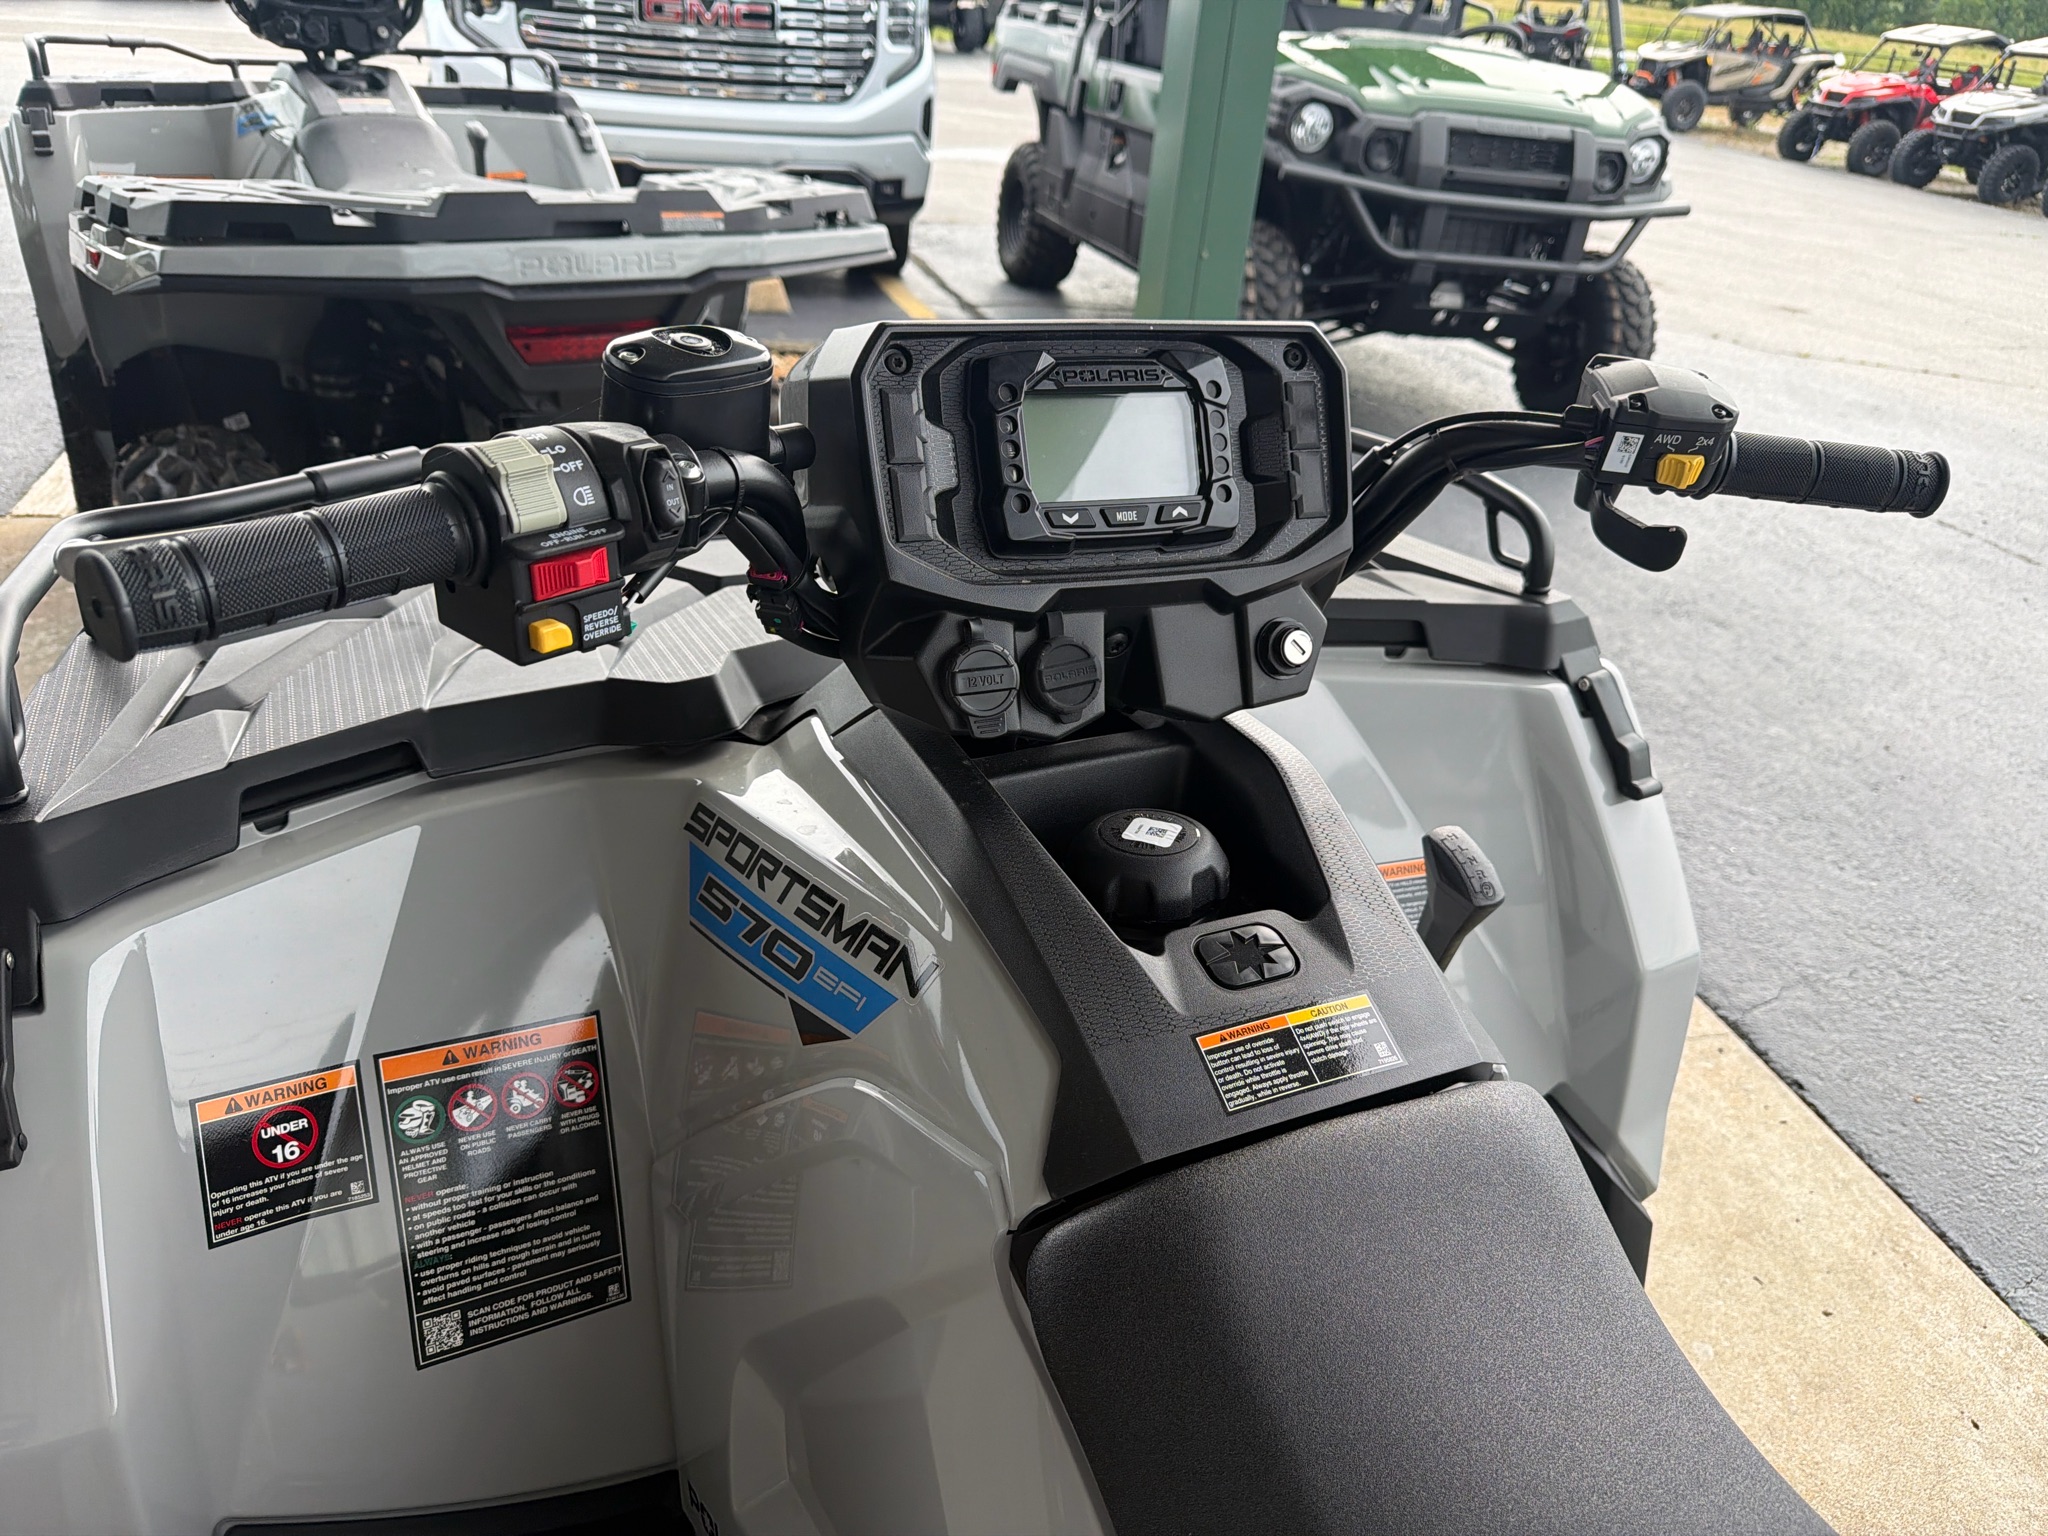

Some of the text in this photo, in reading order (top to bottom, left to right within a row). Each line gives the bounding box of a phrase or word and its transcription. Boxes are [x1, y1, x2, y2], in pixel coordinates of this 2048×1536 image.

[642, 0, 773, 29] GMC
[516, 250, 676, 279] POLARIS
[1062, 370, 1160, 382] POLARIS
[1654, 434, 1714, 447] AWD 2x4
[560, 460, 584, 473] OFF
[666, 498, 680, 506] OUT
[1116, 510, 1138, 522] MODE
[548, 527, 588, 540] ENGINE
[583, 606, 618, 623] SPEEDO/
[584, 616, 619, 632] REVERSE
[583, 624, 622, 642] OVERRIDE
[968, 674, 1004, 688] 12 VOLT
[1045, 664, 1096, 684] POLARIS
[683, 801, 942, 999] SPORTSMAN
[697, 873, 870, 1012] 570 EFI
[1309, 1002, 1348, 1017] CAUTION
[1226, 1021, 1270, 1039] WARNING
[462, 1033, 541, 1058] WARNING
[1206, 1048, 1233, 1060] Improper
[1243, 1042, 1252, 1050] of
[1251, 1037, 1274, 1047] override
[1210, 1058, 1230, 1068] button
[1240, 1050, 1254, 1059] lead
[1272, 1043, 1281, 1051] of
[1214, 1064, 1235, 1074] control
[1234, 1058, 1260, 1069] resulting
[1265, 1052, 1284, 1060] severe
[1283, 1047, 1300, 1055] injury
[386, 1082, 422, 1094] Improper
[424, 1078, 440, 1086] ATV
[471, 1066, 492, 1076] result
[501, 1057, 533, 1070] SEVERE
[534, 1052, 562, 1062] INJURY
[571, 1044, 596, 1054] DEATH
[1224, 1071, 1243, 1081] death.
[1263, 1059, 1285, 1070] activate
[1221, 1079, 1245, 1090] override
[1244, 1075, 1260, 1083] while
[1260, 1069, 1281, 1079] throttle
[1224, 1070, 1308, 1098] engaged. Always apply throttle
[244, 1077, 327, 1107] WARNING
[1228, 1094, 1257, 1107] gradually,
[1256, 1089, 1272, 1097] while
[1278, 1081, 1301, 1091] reverse.
[559, 1111, 600, 1126] WITH DRUGS
[561, 1105, 596, 1119] NEVER USE
[260, 1118, 308, 1138] UNDER
[505, 1116, 551, 1132] NEVER CARRY
[507, 1123, 552, 1138] PASSENGERS
[571, 1119, 601, 1131] ALCOHOL
[458, 1129, 496, 1143] NEVER USE
[471, 1137, 496, 1147] PUBLIC
[272, 1140, 300, 1163] 16
[400, 1141, 445, 1156] ALWAYS USE
[410, 1148, 448, 1162] APPROVED
[467, 1146, 491, 1156] ROADS
[401, 1156, 446, 1171] HELMET AND
[403, 1164, 447, 1179] PROTECTIVE
[210, 1184, 247, 1199] Operating
[248, 1180, 263, 1188] this
[264, 1174, 278, 1183] ATV
[286, 1170, 300, 1179] you
[313, 1160, 334, 1170] under
[231, 1187, 268, 1201] increases
[269, 1182, 285, 1192] your
[287, 1174, 313, 1186] chance
[314, 1170, 322, 1179] of
[323, 1166, 348, 1176] severe
[417, 1174, 437, 1183] GEAR
[404, 1184, 468, 1203] NEVER operate:
[411, 1198, 441, 1211] without
[442, 1192, 469, 1205] proper
[470, 1184, 501, 1196] training
[512, 1170, 553, 1185] instruction
[212, 1206, 233, 1216] injury
[245, 1196, 269, 1207] death.
[214, 1217, 242, 1229] NEVER
[243, 1208, 273, 1221] operate
[275, 1204, 289, 1212] this
[291, 1198, 305, 1207] ATV
[313, 1193, 328, 1202] you
[215, 1218, 267, 1237] under age 16.
[467, 1265, 622, 1318] SCAN CODE FOR PRODUCT AND SAFETY
[468, 1287, 580, 1326] INFORMATION. FOLLOW ALL
[469, 1312, 529, 1335] INSTRUCTIONS
[531, 1306, 548, 1316] AND
[549, 1292, 593, 1310] WARNINGS.
